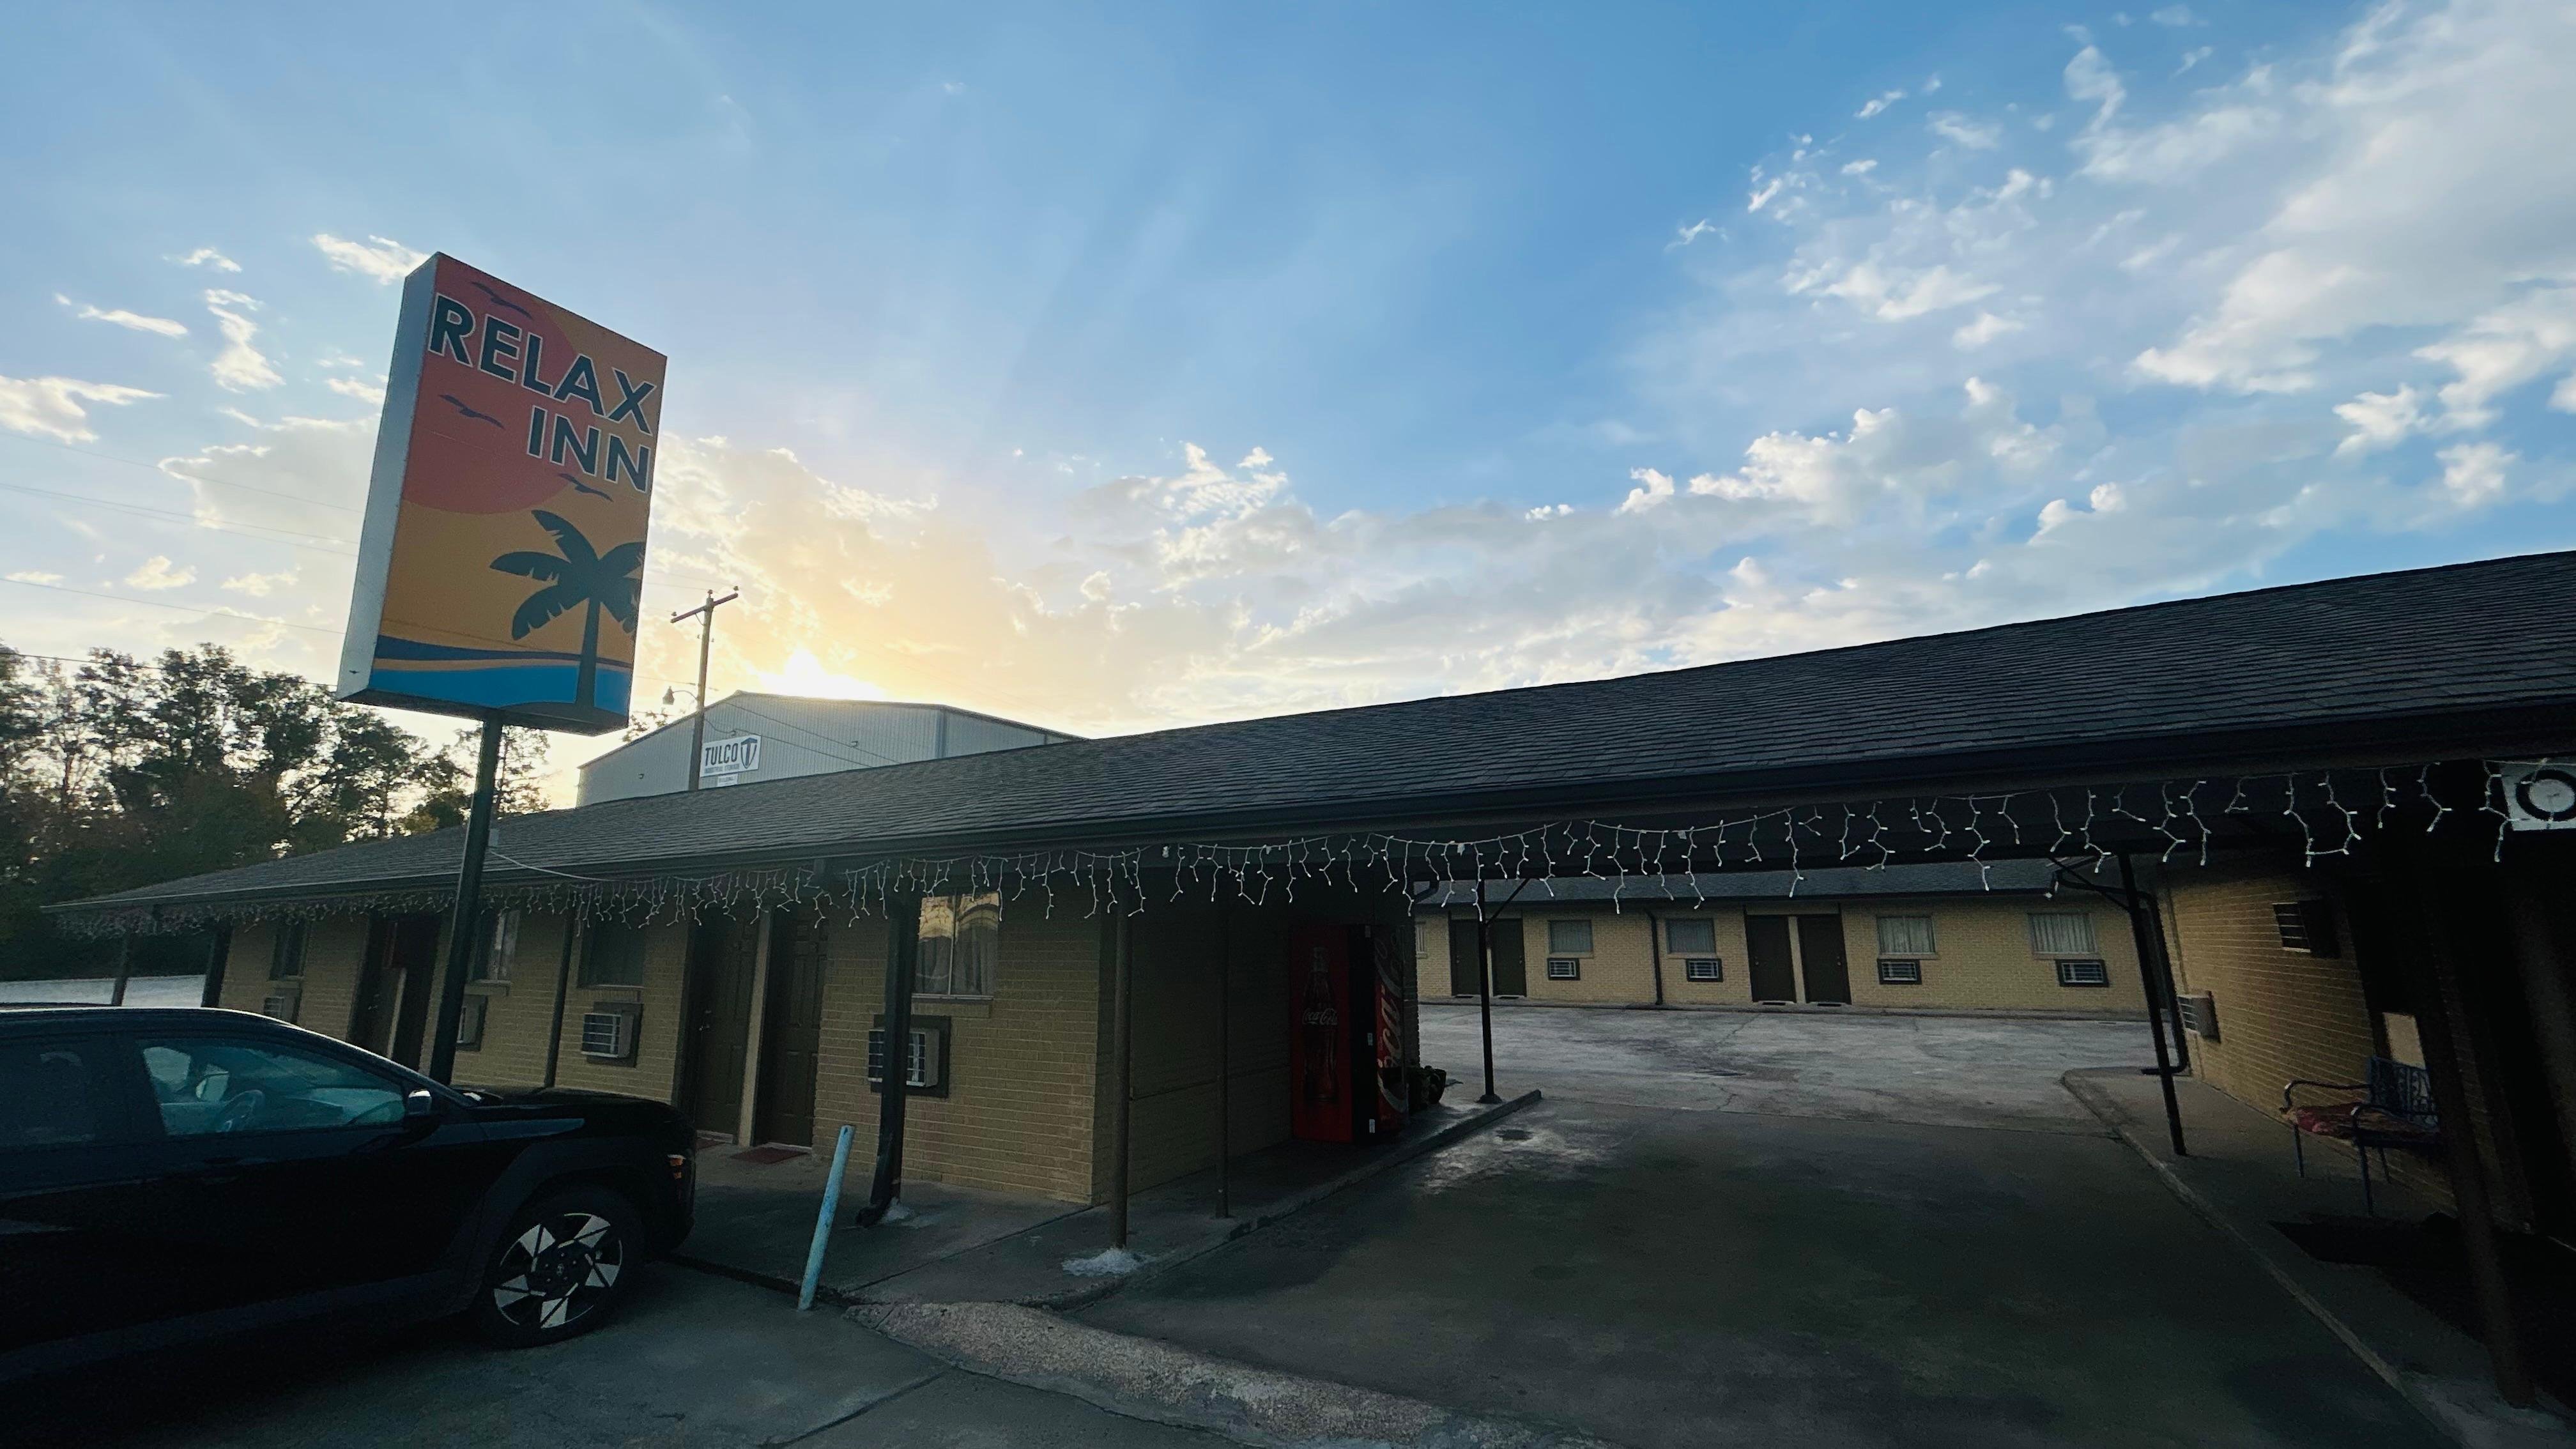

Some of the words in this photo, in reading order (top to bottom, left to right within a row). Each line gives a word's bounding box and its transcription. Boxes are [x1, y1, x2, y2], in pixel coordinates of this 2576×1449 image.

[428, 293, 657, 436] RELAX
[526, 405, 651, 493] INN
[705, 743, 739, 767] TULCO
